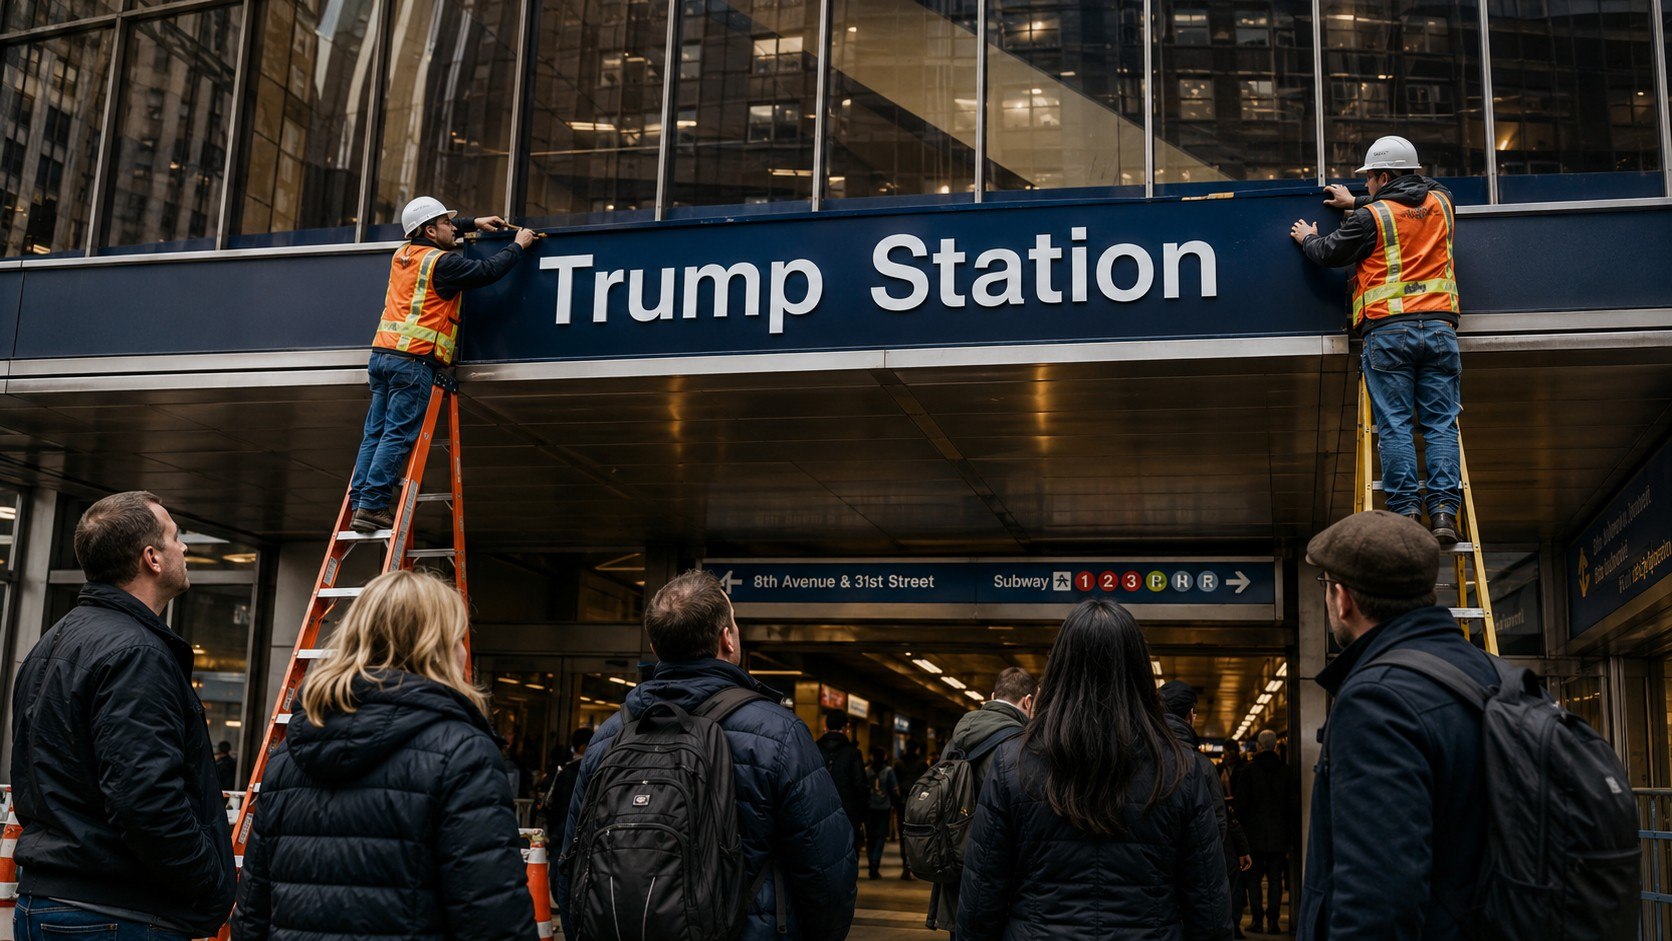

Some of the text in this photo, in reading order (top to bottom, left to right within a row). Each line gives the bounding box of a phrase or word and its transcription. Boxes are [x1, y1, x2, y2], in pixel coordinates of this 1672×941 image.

[539, 226, 1218, 335] Trump Station
[753, 574, 935, 588] 8th Avenue & 31st Street
[993, 574, 1050, 591] Subway
